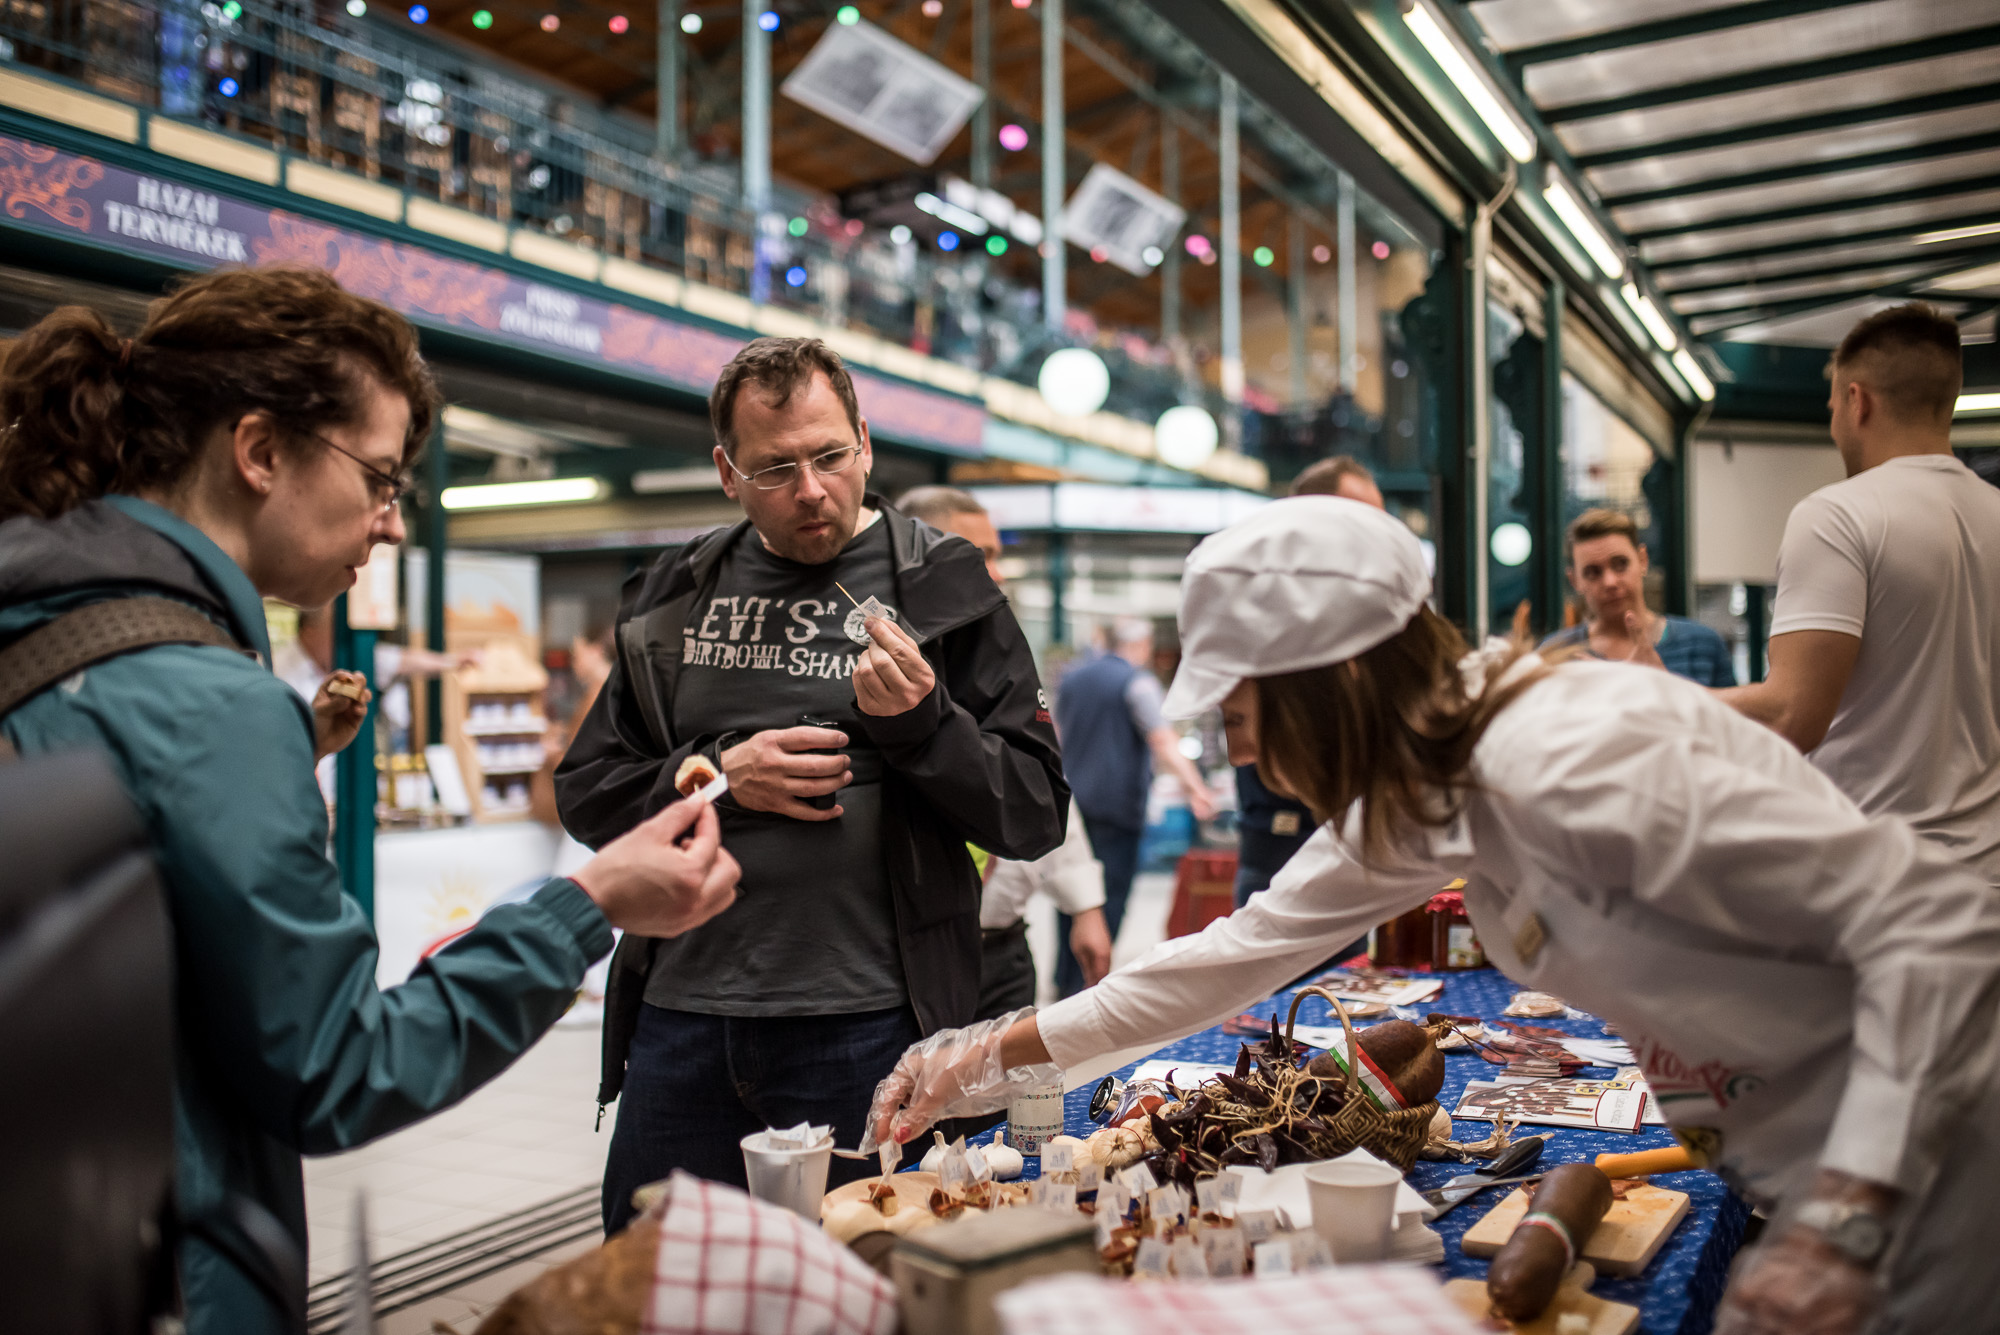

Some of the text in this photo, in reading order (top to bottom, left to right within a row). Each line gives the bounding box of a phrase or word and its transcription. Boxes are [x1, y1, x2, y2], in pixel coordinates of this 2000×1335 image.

[137, 176, 219, 226] HAZAI
[683, 596, 824, 644] EVI'S
[682, 637, 785, 669] DIRTBOWL
